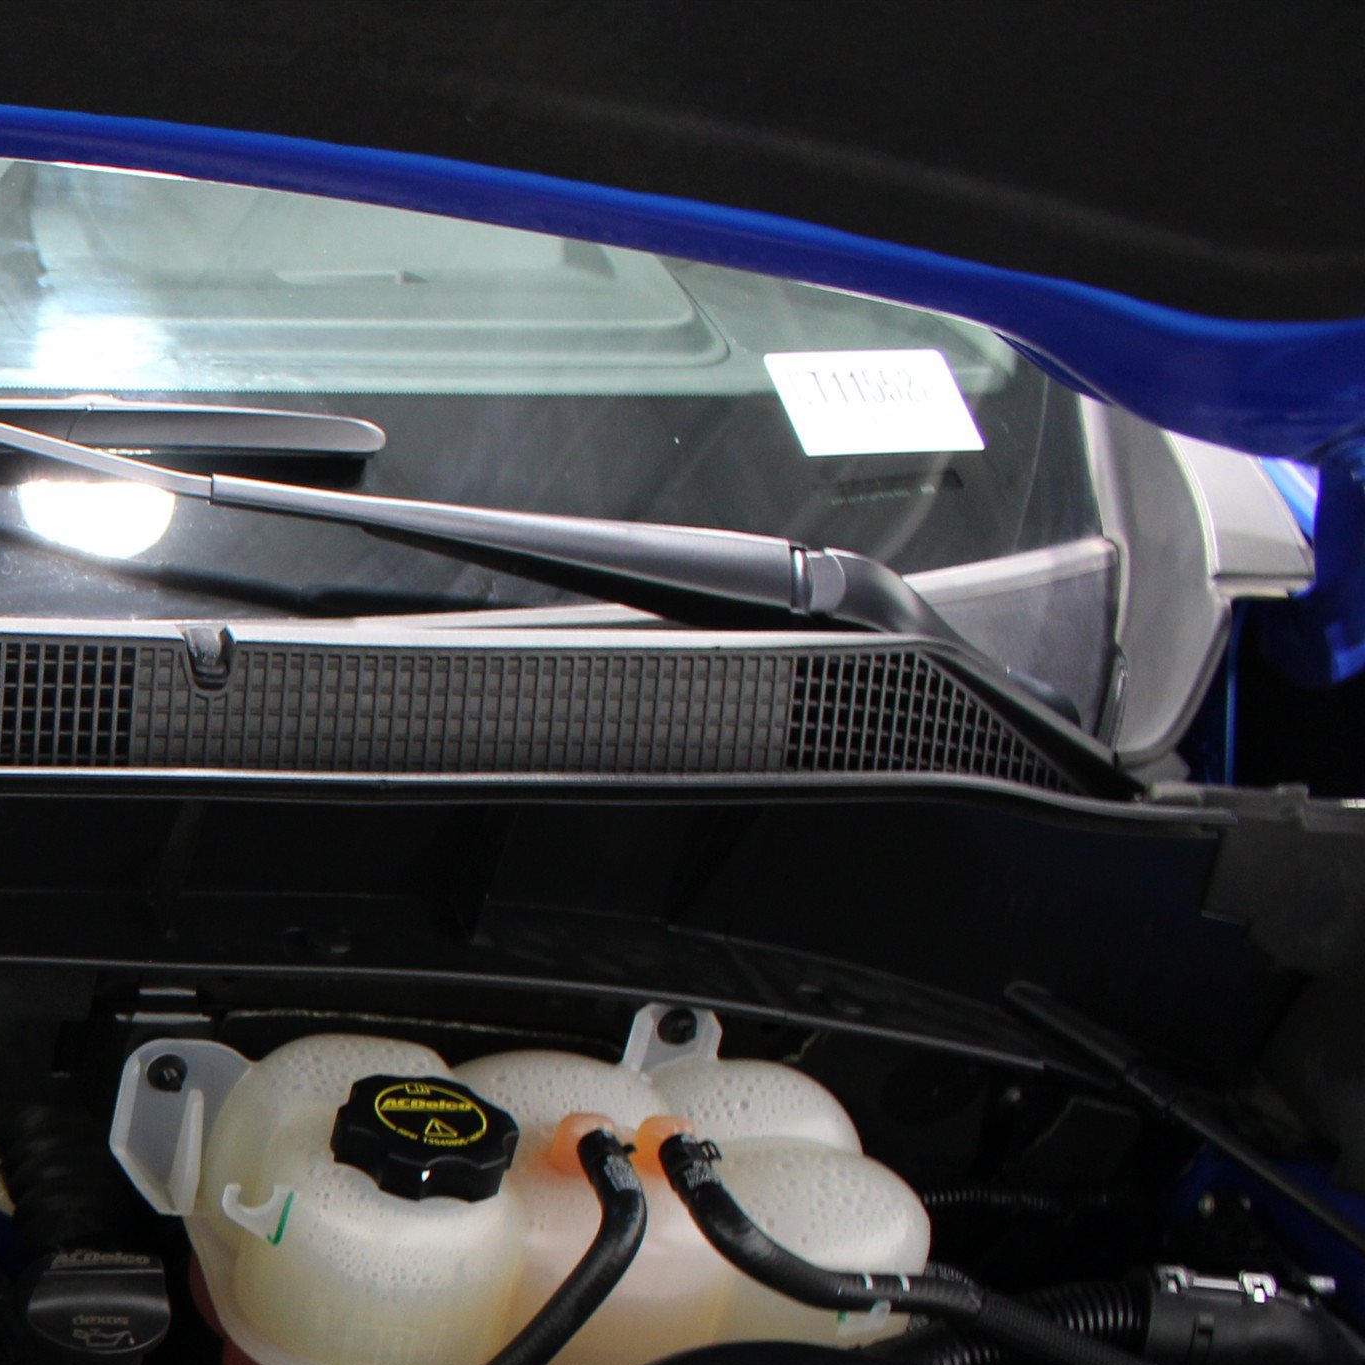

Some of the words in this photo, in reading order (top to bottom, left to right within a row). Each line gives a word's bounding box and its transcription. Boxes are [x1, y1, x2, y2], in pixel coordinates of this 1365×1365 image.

[379, 1097, 474, 1112] ACDelco
[51, 1249, 151, 1268] ACDelco
[72, 1314, 130, 1325] dexos
